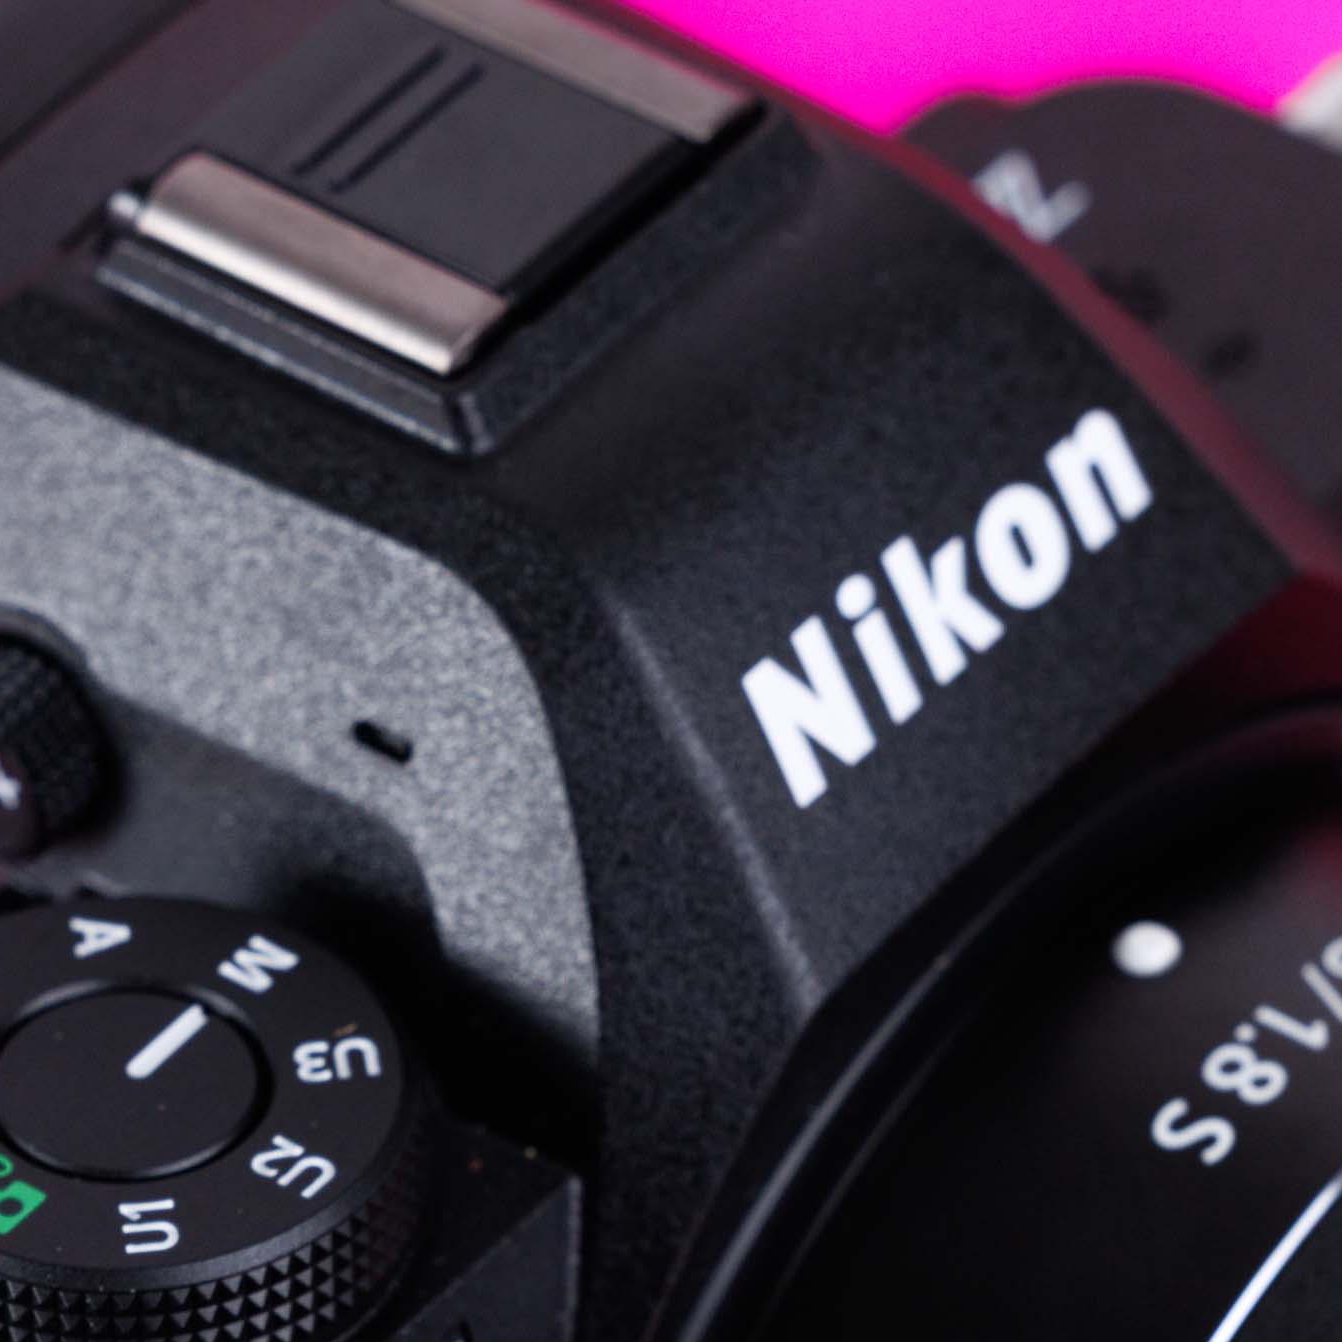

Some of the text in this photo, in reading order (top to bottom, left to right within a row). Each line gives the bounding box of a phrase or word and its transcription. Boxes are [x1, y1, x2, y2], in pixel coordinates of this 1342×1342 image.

[740, 408, 1153, 809] Nikon
[68, 916, 132, 958] A
[217, 934, 300, 994] M
[292, 1036, 382, 1084] U3
[1150, 1096, 1237, 1165] S
[249, 1133, 337, 1200] U2
[117, 1197, 181, 1255] U1
